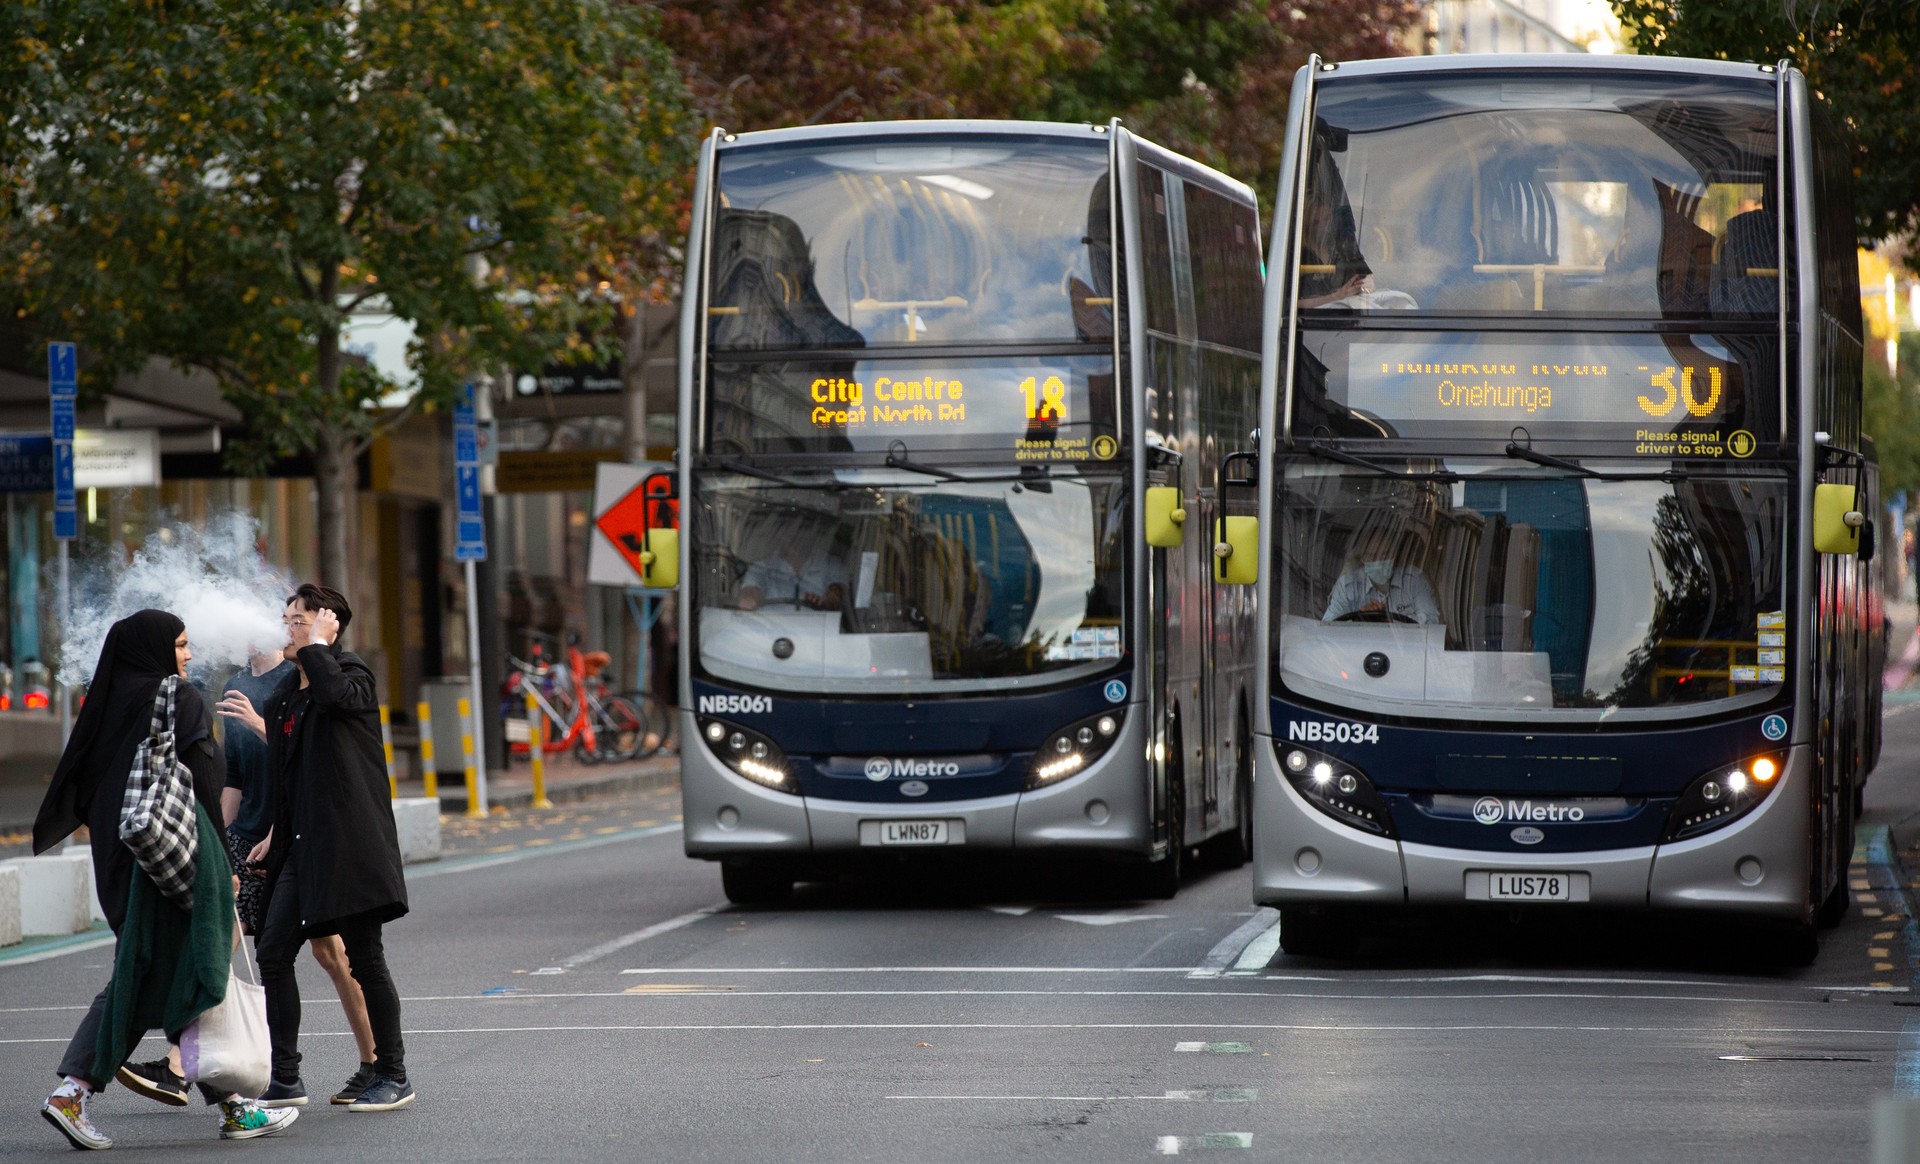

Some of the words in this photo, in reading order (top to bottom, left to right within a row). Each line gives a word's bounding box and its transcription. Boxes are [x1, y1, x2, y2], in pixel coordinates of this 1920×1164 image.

[811, 378, 863, 407] City
[874, 376, 963, 401] Centre
[1019, 375, 1067, 419] 18
[1438, 379, 1552, 413] Onehunga
[1637, 366, 1721, 417] 30
[873, 404, 933, 422] North
[1015, 438, 1051, 449] Please
[1053, 437, 1087, 451] signal
[1635, 430, 1678, 442] Please
[1681, 430, 1720, 445] signal
[1015, 449, 1049, 460] driver
[1050, 450, 1063, 459] to
[1064, 449, 1090, 461] stop
[1635, 442, 1675, 454] driver
[1677, 444, 1691, 454] to
[1694, 444, 1723, 458] stop
[699, 694, 774, 714] NB5061
[1289, 720, 1380, 744] NB5034
[893, 758, 960, 777] Metro
[1507, 799, 1585, 822] Metro
[887, 823, 940, 841] LWN87
[1499, 877, 1560, 896] LUS78
